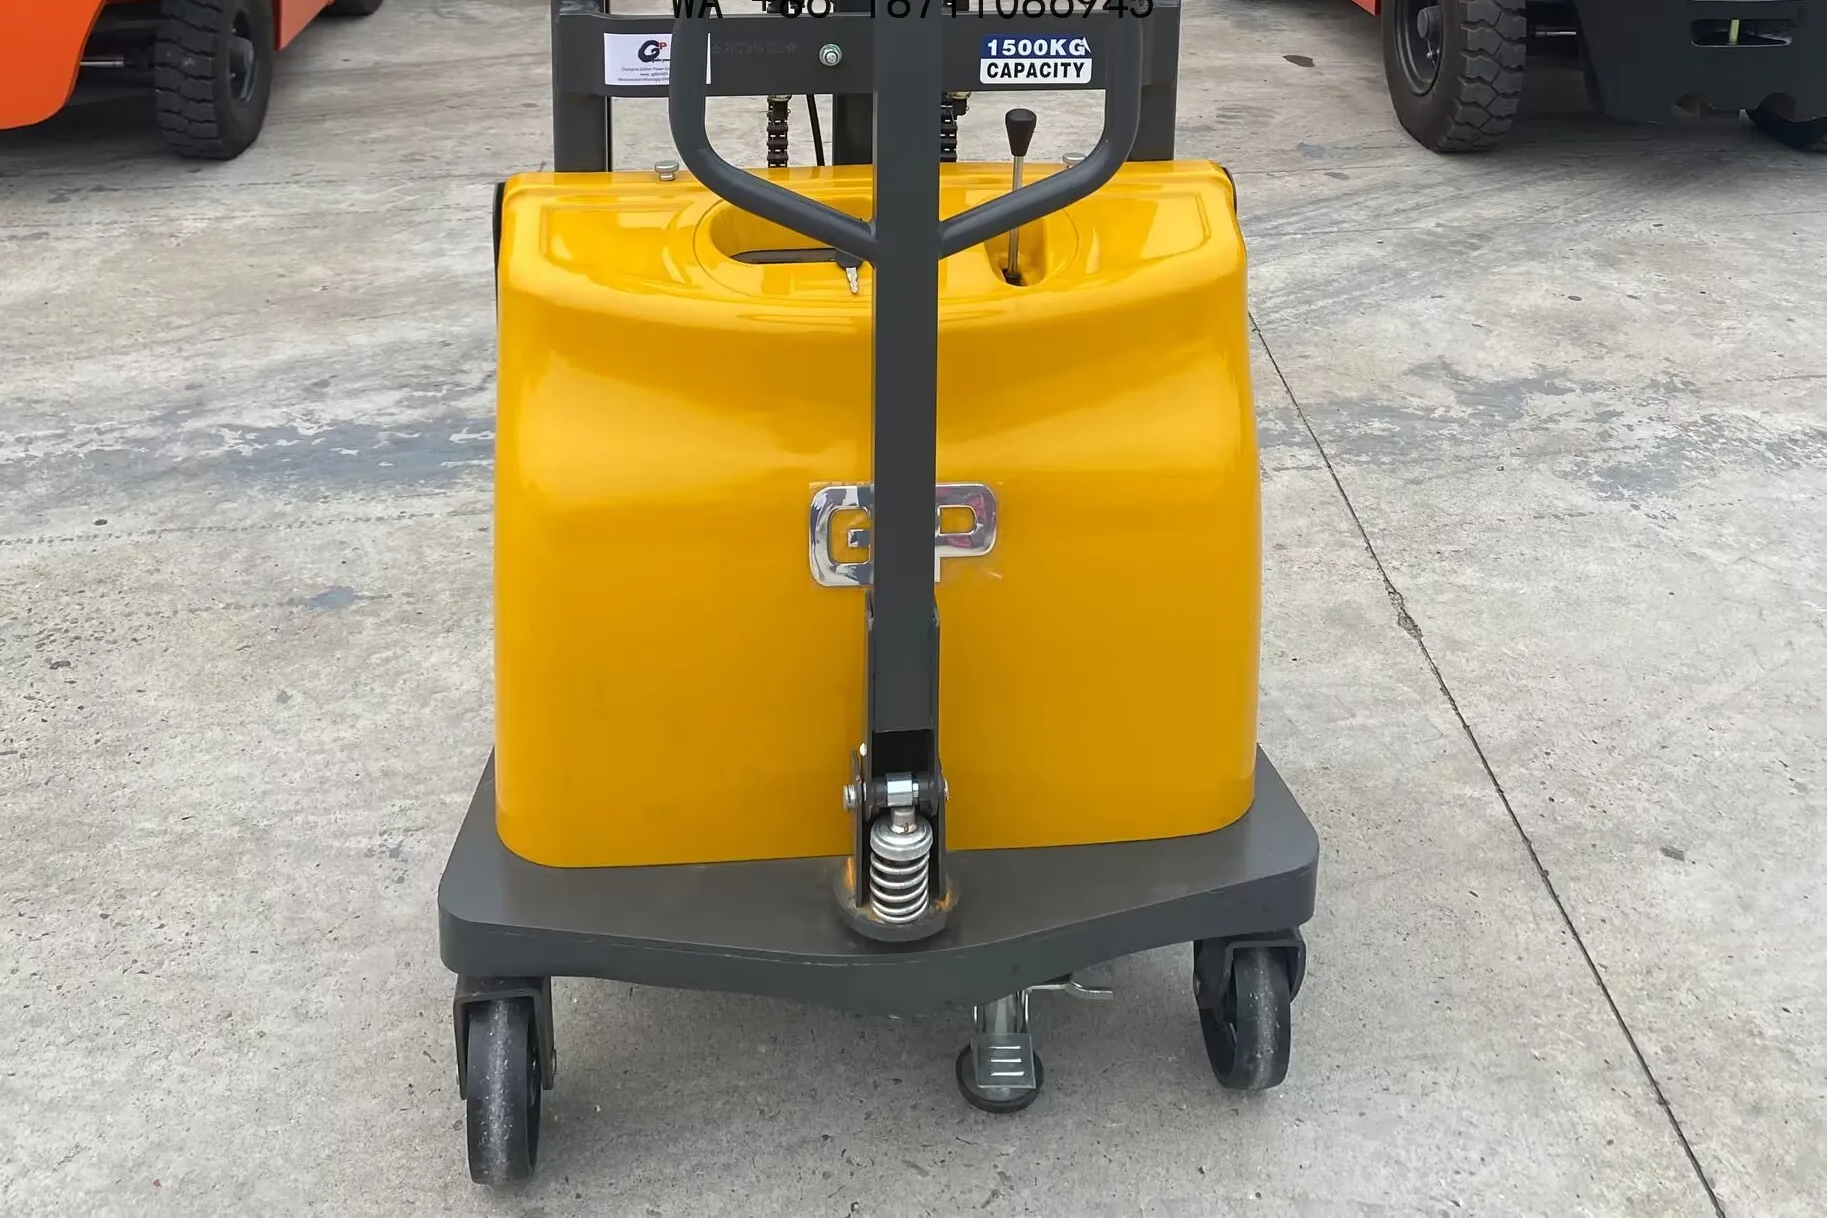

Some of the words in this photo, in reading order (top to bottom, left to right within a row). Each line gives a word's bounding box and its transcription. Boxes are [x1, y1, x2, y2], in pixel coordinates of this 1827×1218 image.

[987, 38, 1087, 56] 1500KG
[986, 62, 1085, 79] CAPACITY
[808, 483, 997, 587] GP
